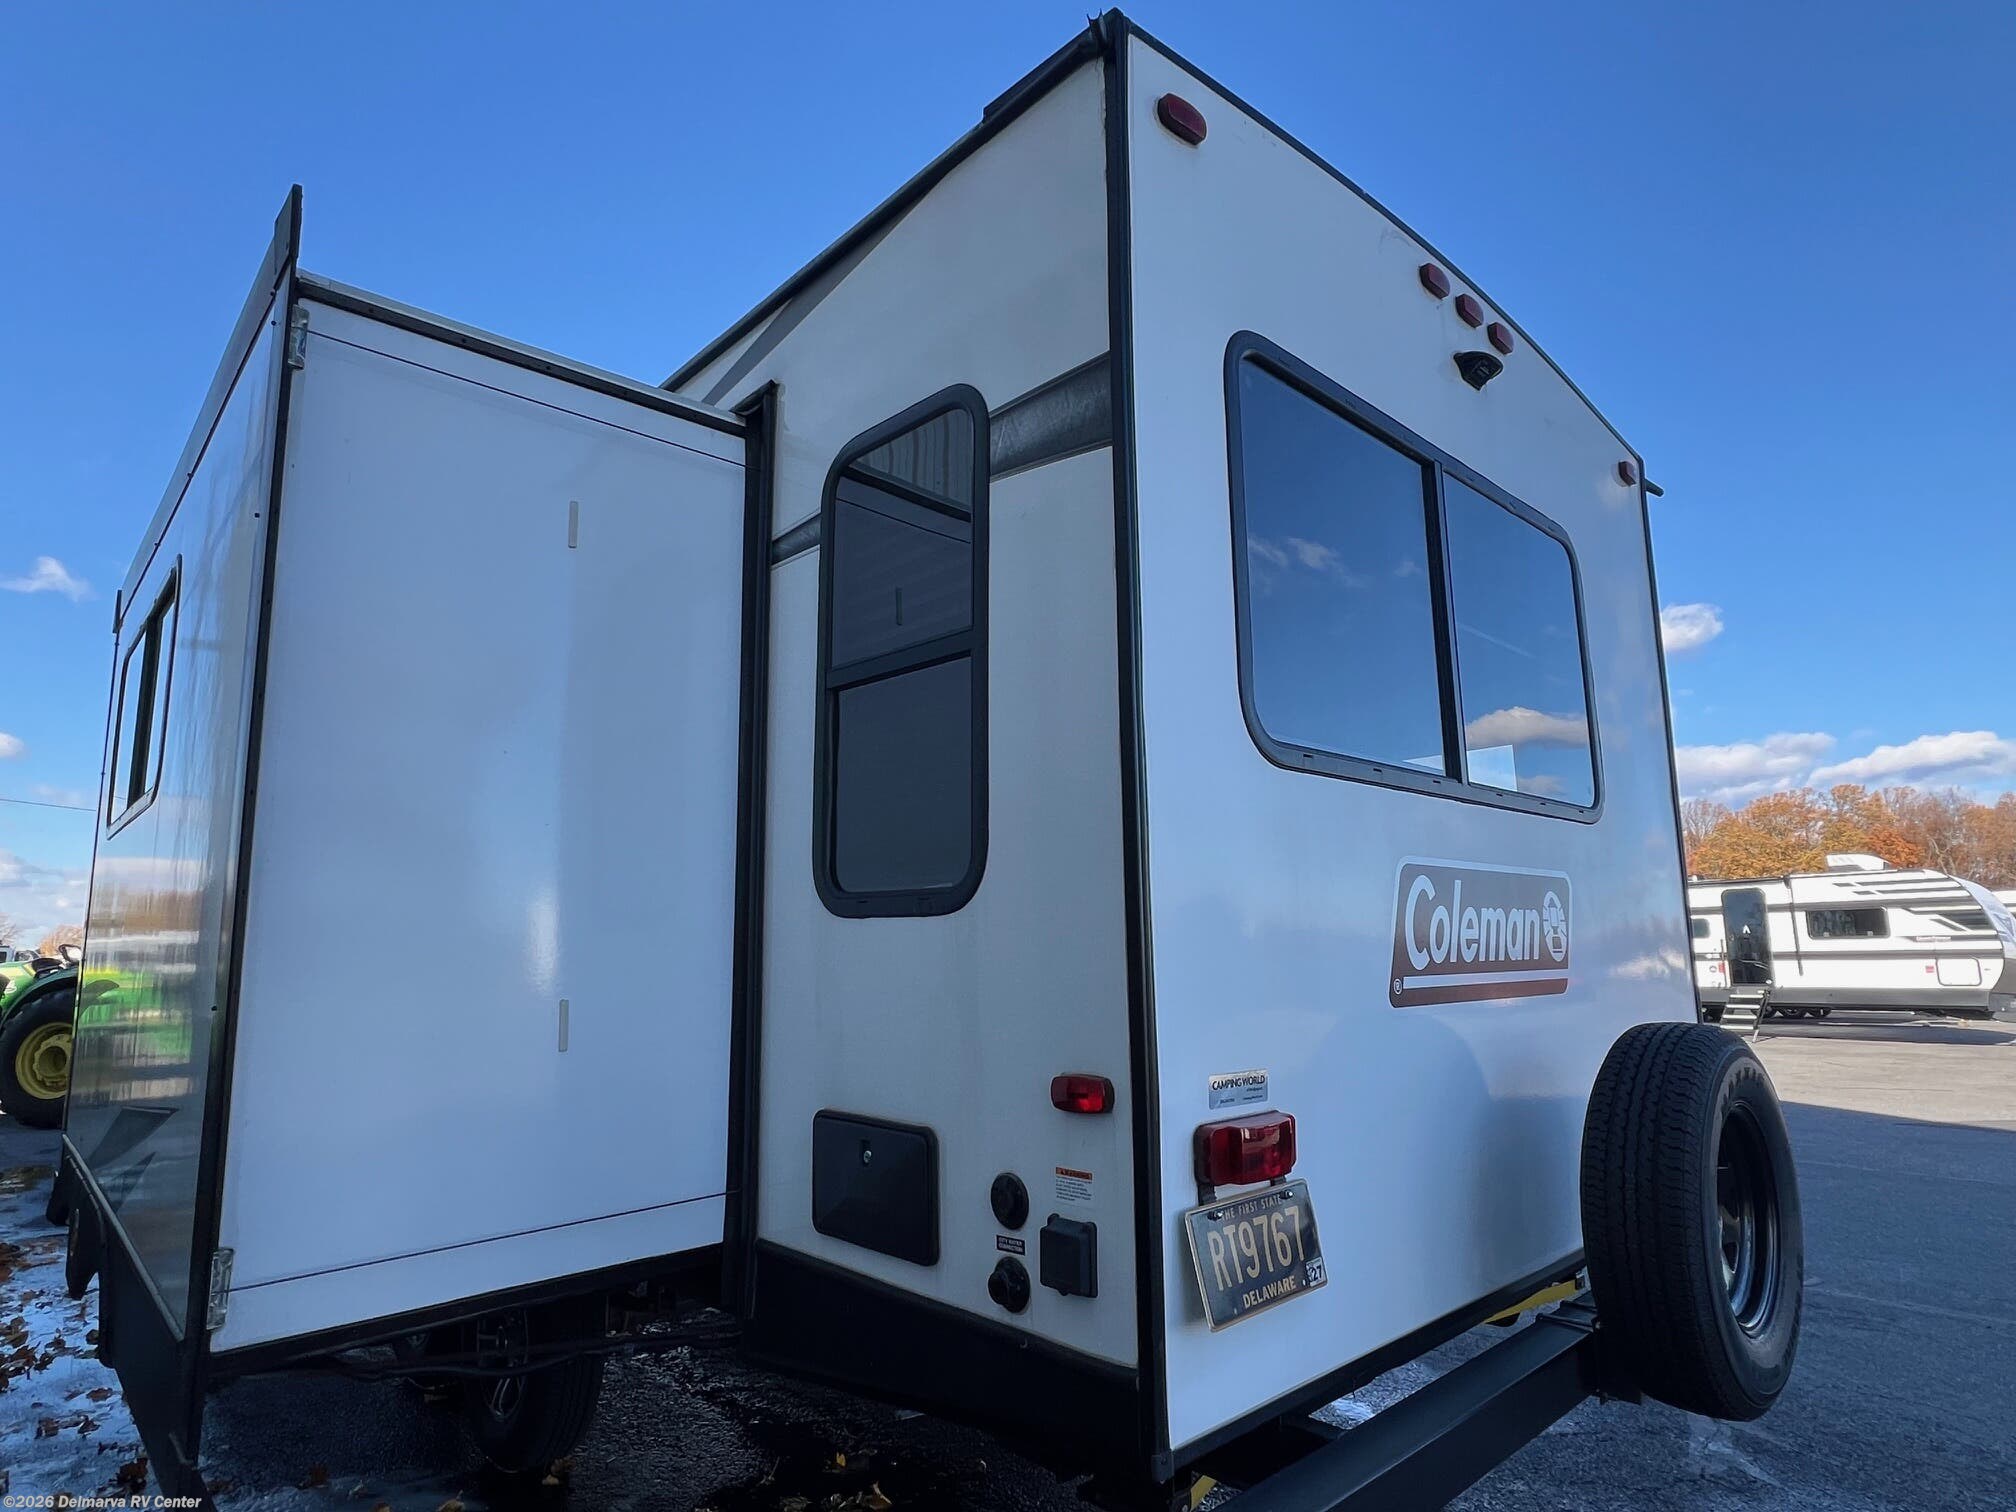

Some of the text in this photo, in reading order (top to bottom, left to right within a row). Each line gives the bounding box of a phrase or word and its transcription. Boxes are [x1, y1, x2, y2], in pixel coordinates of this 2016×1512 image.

[1405, 874, 1540, 971] Coleman
[1212, 1077, 1242, 1090] CAMPING
[1243, 1075, 1266, 1086] WORLD
[1221, 1194, 1282, 1221] THE FIRST STATE
[1207, 1205, 1304, 1291] RT9767
[1242, 1275, 1297, 1309] DELAWARE
